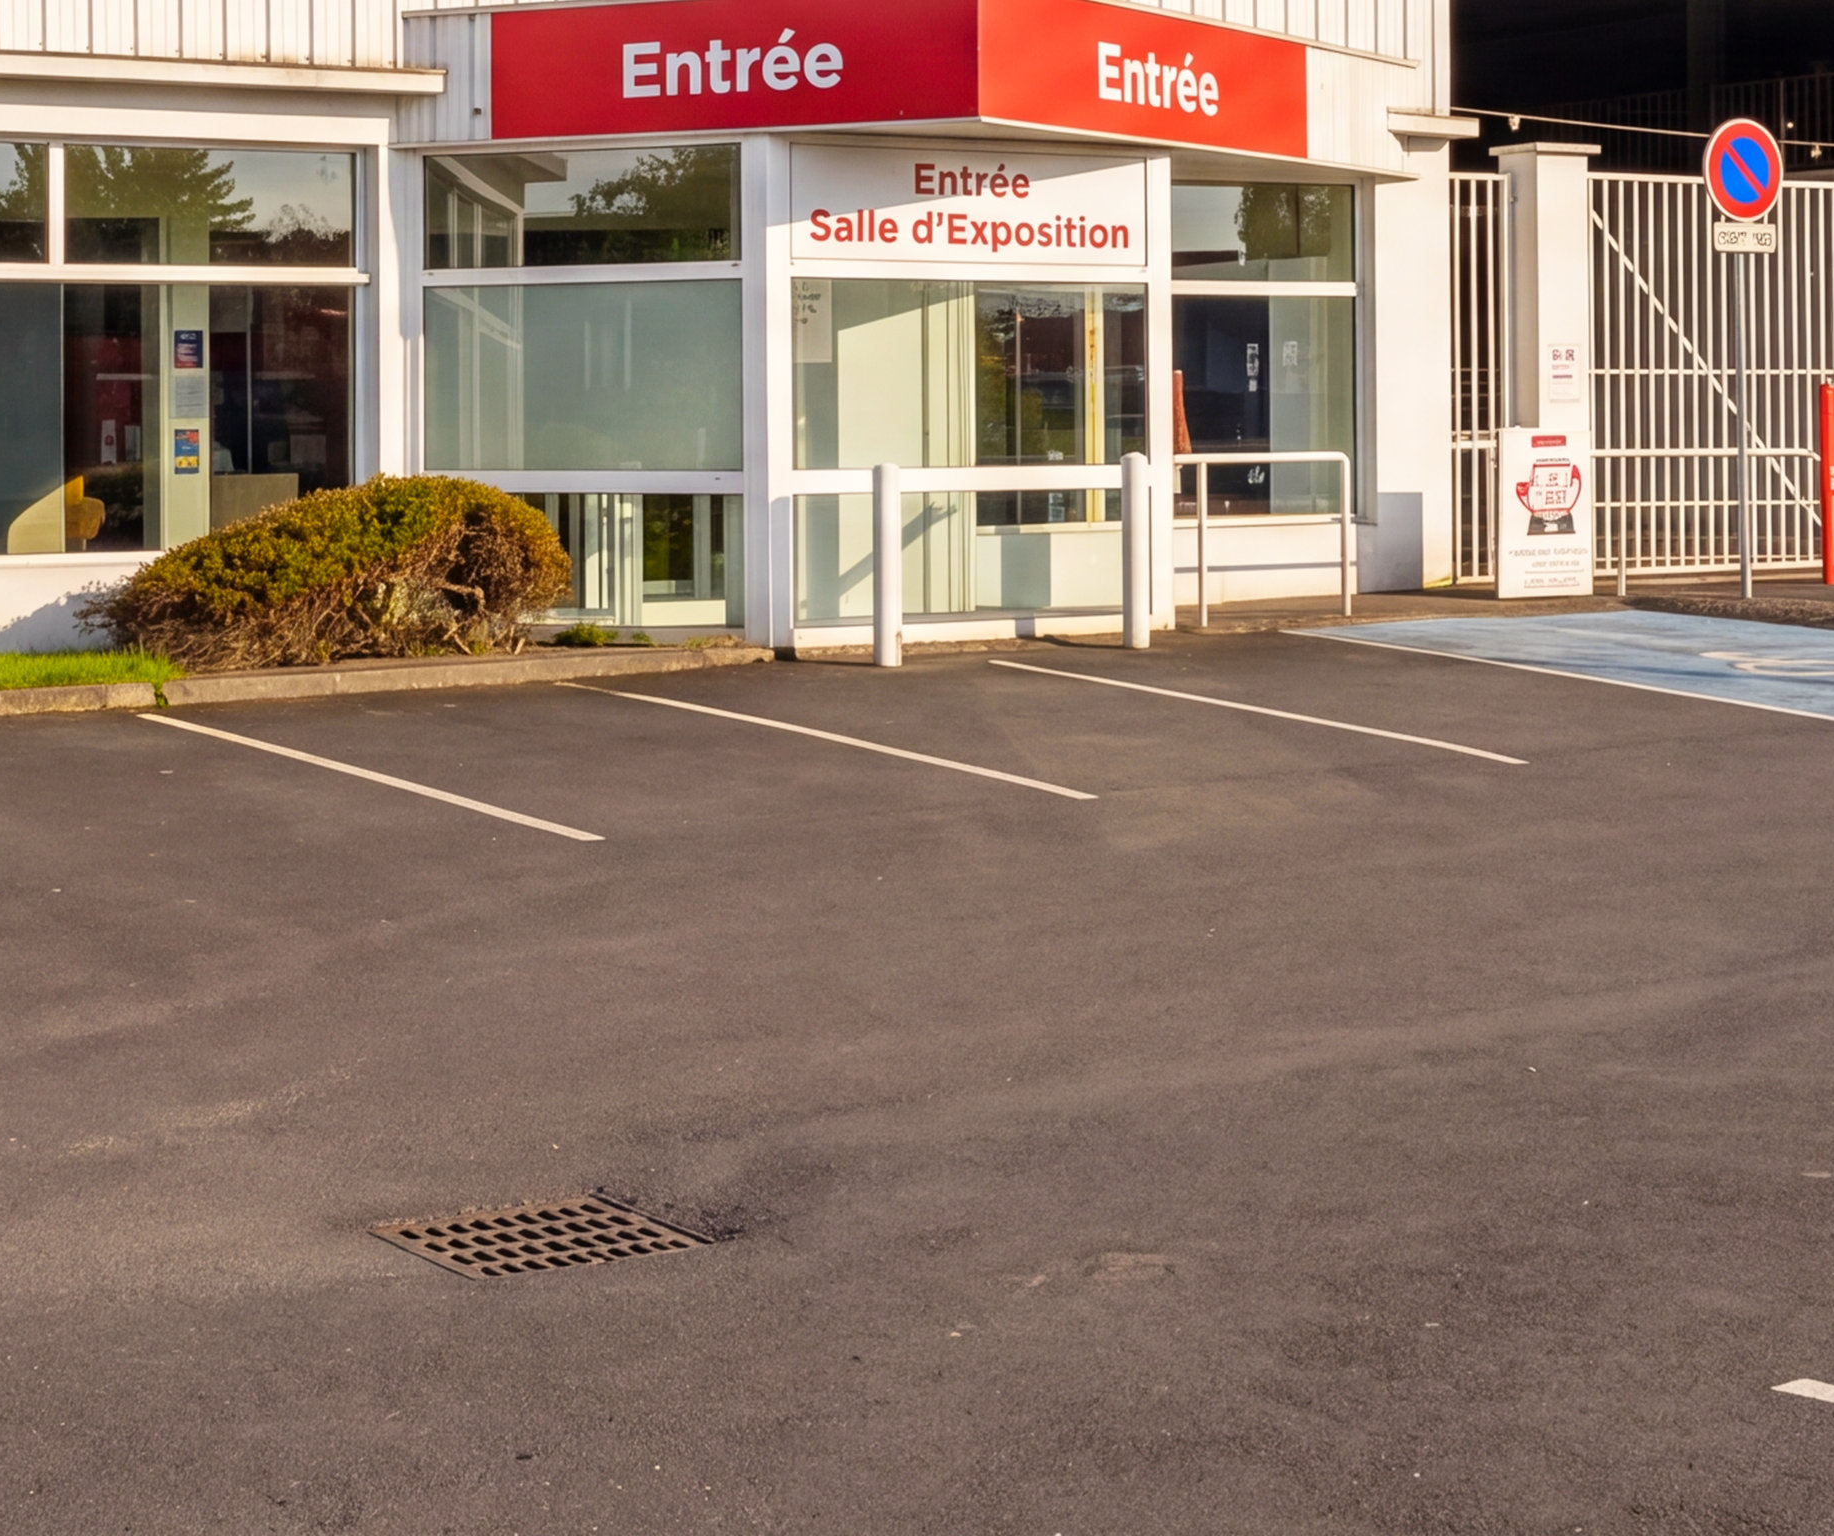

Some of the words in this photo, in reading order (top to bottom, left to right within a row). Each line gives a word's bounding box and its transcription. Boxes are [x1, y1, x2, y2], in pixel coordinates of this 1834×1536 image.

[622, 27, 844, 100] Entrée
[1097, 40, 1220, 117] Entrée
[915, 163, 1031, 199] Entrée
[810, 208, 899, 244] Salle
